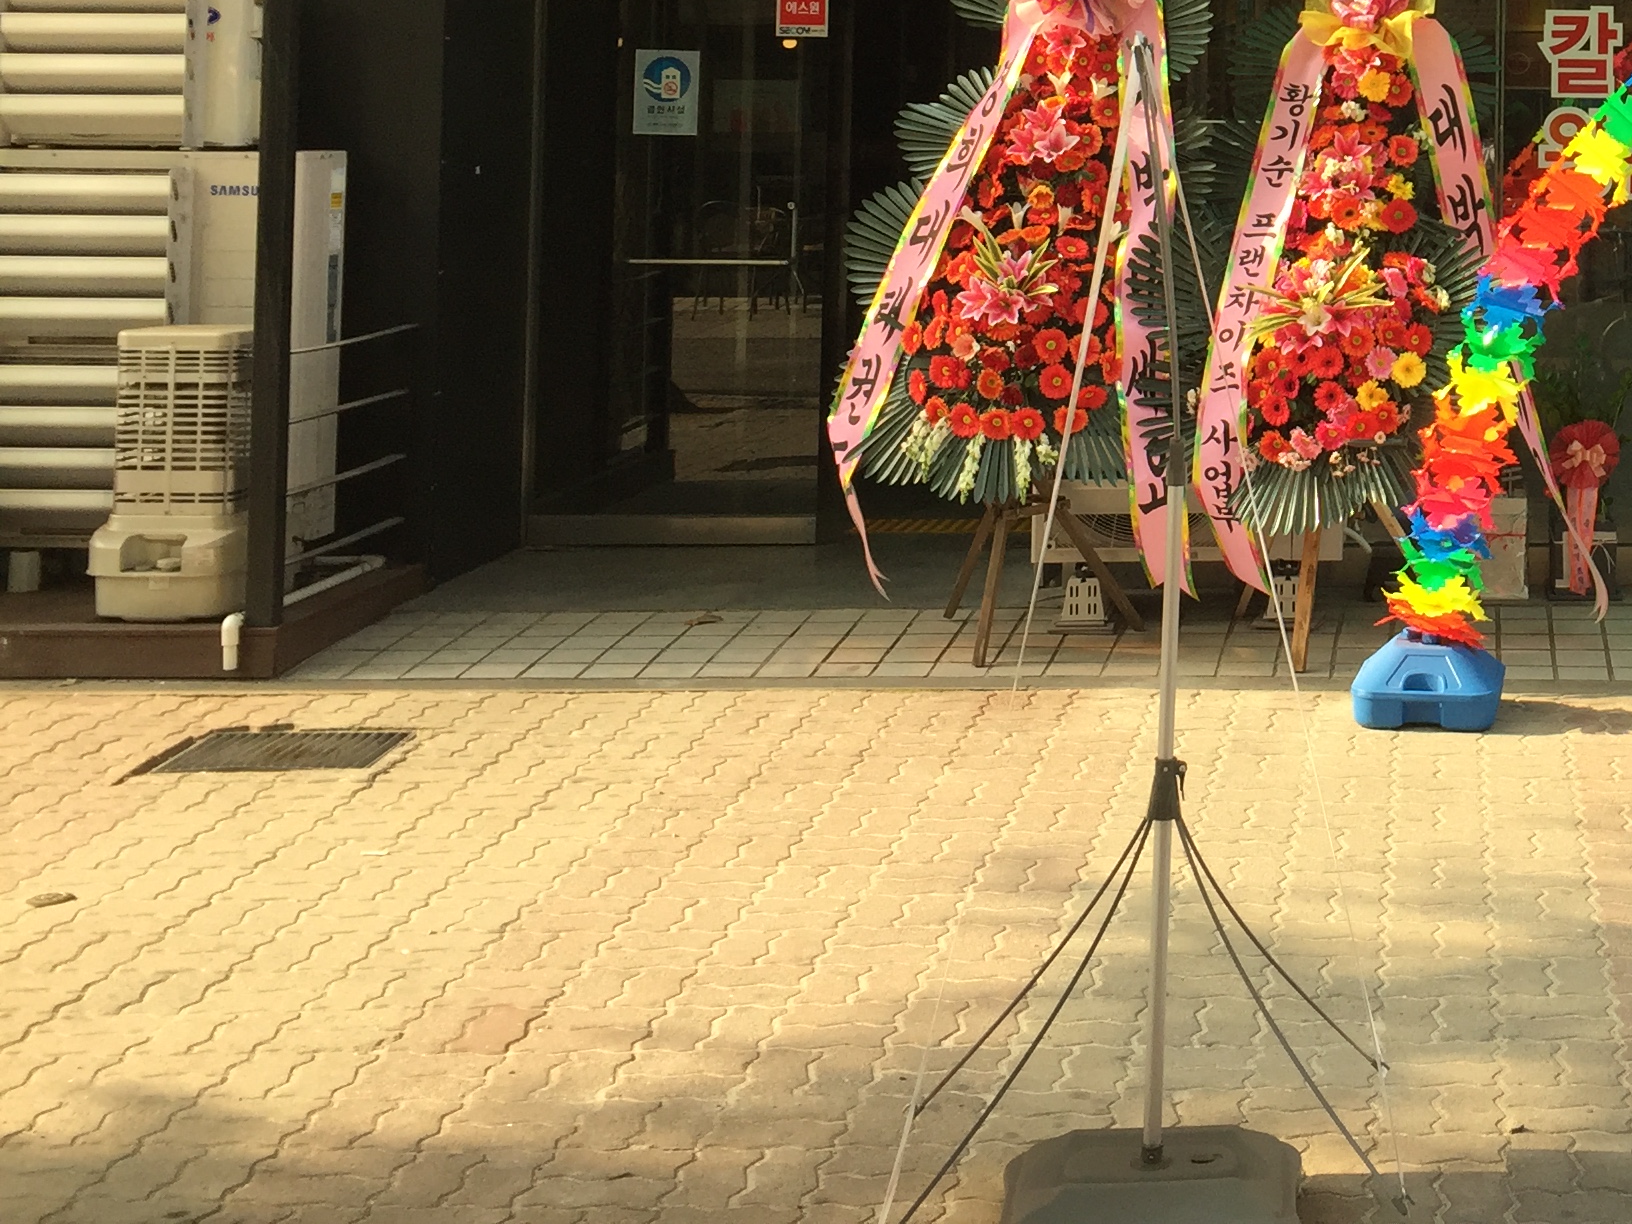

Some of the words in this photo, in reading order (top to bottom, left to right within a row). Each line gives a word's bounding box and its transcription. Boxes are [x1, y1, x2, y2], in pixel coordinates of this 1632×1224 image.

[785, 1, 820, 15] 에스원
[1261, 83, 1313, 189] 황기순
[210, 185, 259, 196] SAMSU
[1209, 212, 1276, 392] 프랜차이즈
[1202, 419, 1242, 534] 사업부
